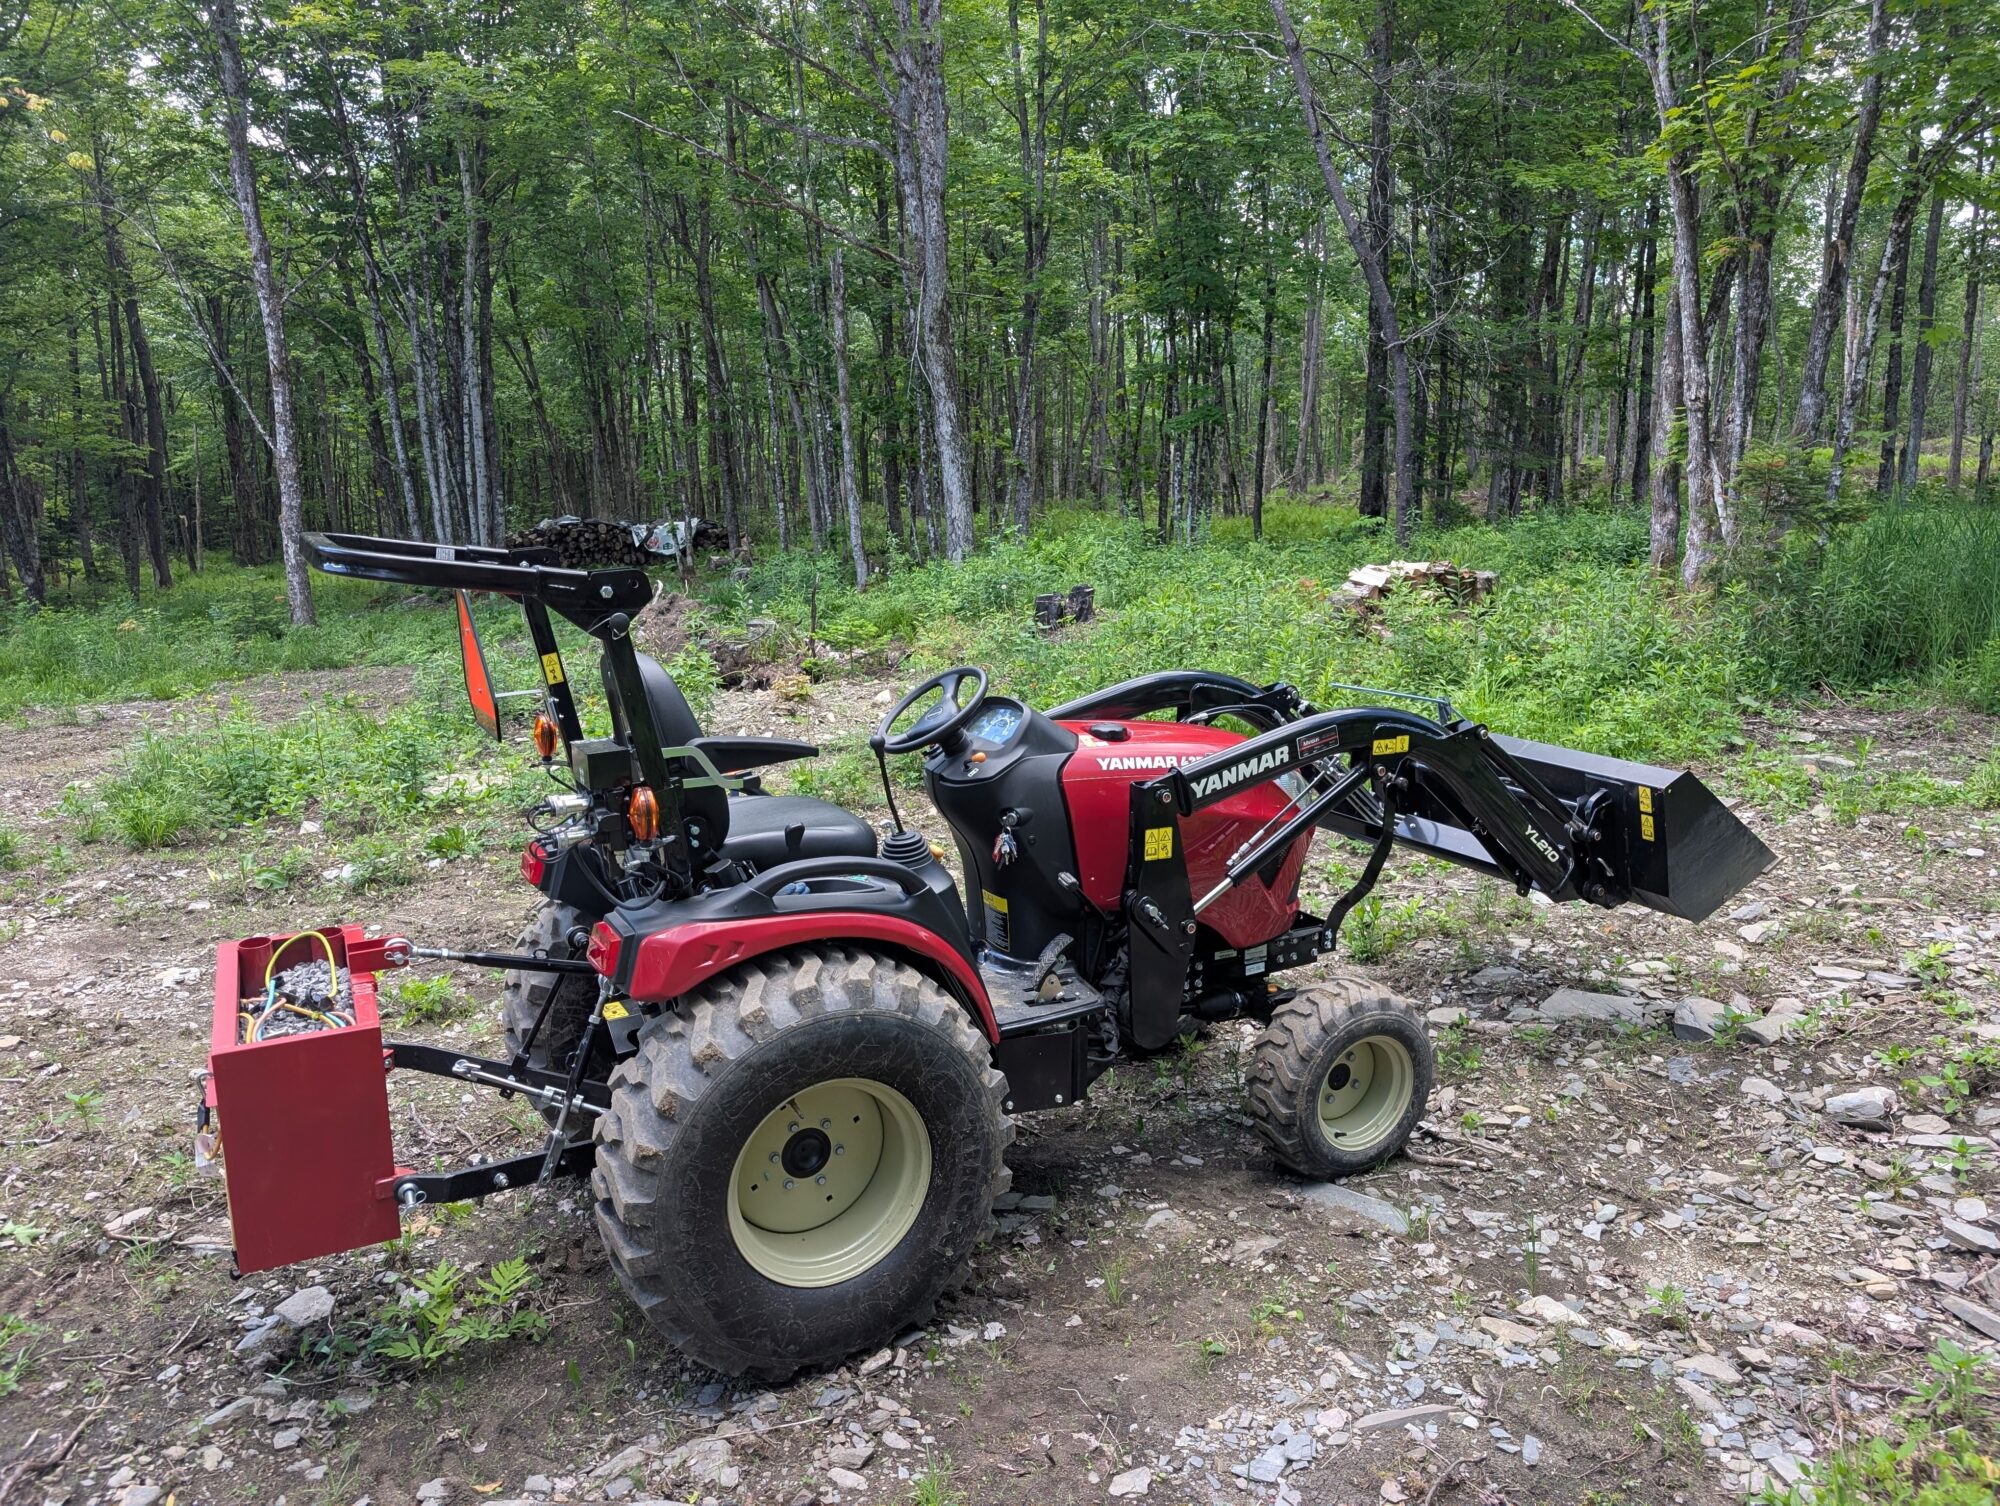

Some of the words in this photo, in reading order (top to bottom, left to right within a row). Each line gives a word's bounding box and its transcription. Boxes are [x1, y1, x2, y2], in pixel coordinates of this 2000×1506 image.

[1096, 756, 1178, 770] YANMAR
[1190, 745, 1289, 799] YANMAR
[1525, 823, 1560, 863] YL210
